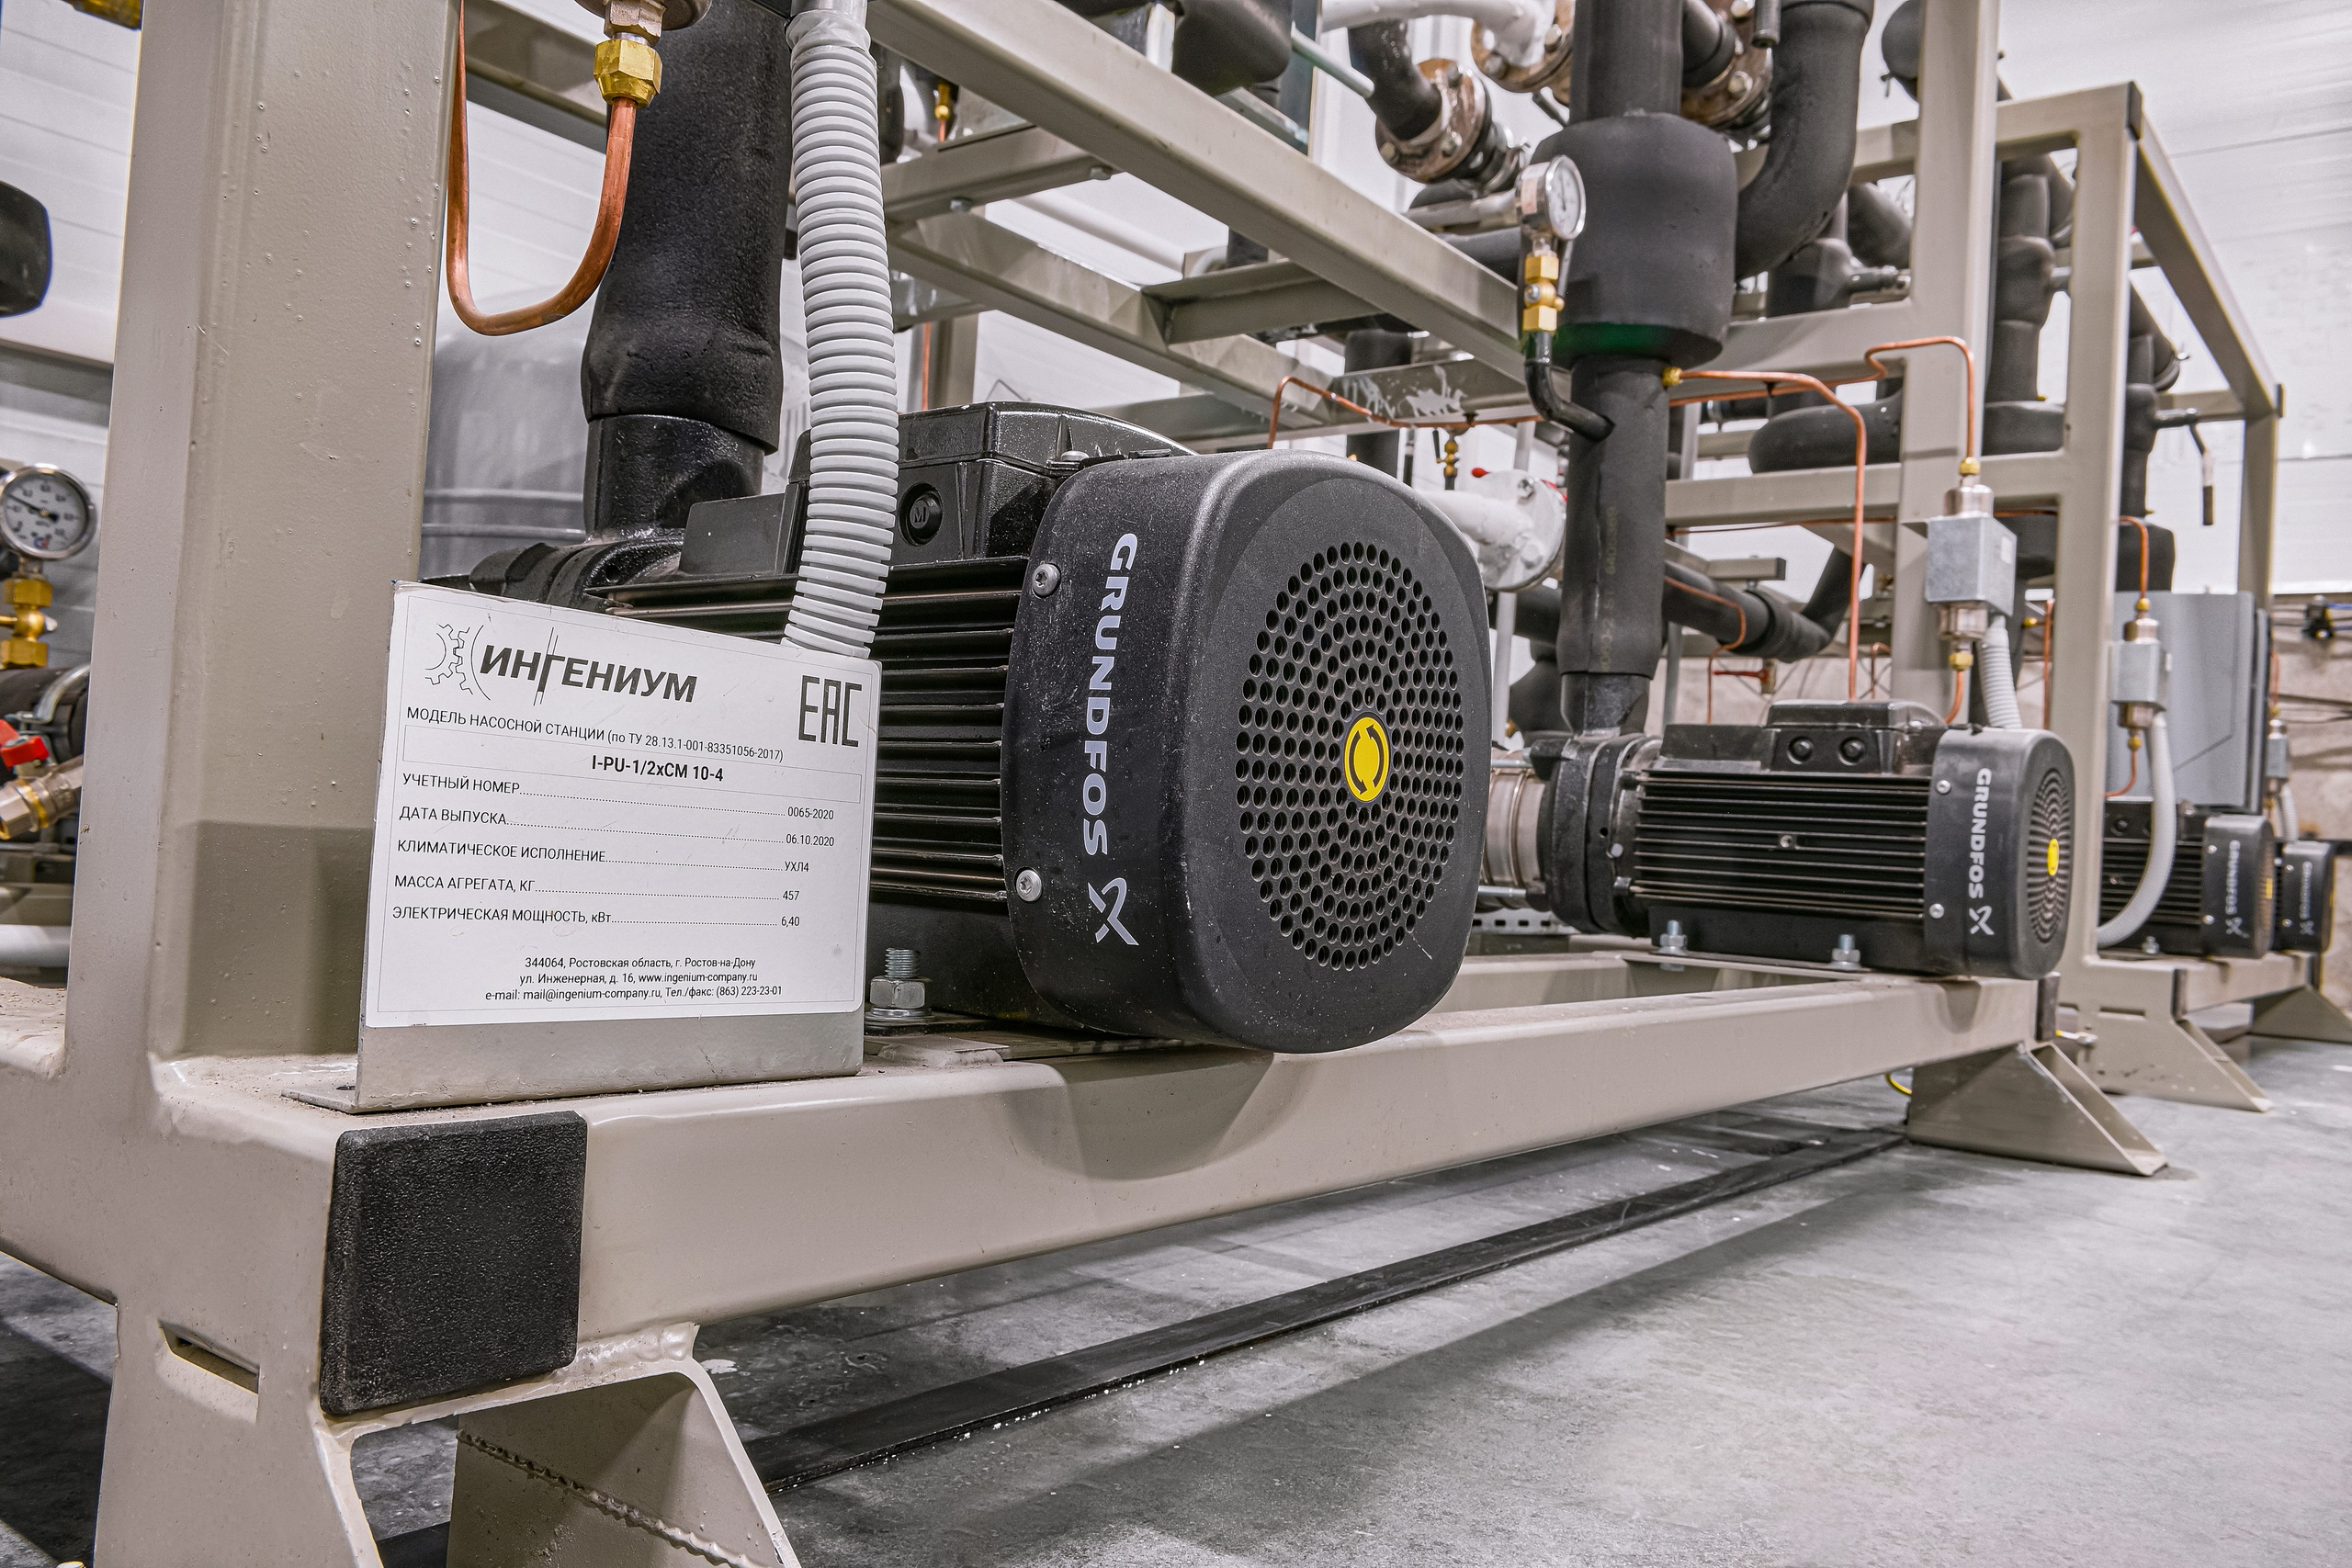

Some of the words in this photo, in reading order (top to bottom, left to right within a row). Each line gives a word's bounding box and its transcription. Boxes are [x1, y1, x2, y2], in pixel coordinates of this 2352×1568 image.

[480, 643, 697, 703] ИНГЕНИУМ
[1082, 533, 1138, 856] GRUNDFOS
[407, 706, 466, 724] МОДЕЛЬ
[470, 714, 541, 733] НАСОСНОЙ
[546, 723, 604, 740] СТАНЦИИ
[608, 729, 625, 744] (по
[628, 733, 642, 744] ТУ
[645, 734, 784, 762] 28.13.1-001-83351056-2017)
[694, 766, 723, 782] 10-4
[403, 773, 469, 790] УЧЕТНЫЙ
[788, 807, 833, 819] 0065-2020
[399, 807, 437, 821] ДАТА
[786, 834, 834, 846] 06.10.2020
[1968, 768, 1992, 899] GRUNDFOS
[398, 840, 517, 857] КЛИМАТИЧЕСКОЕ
[785, 862, 808, 872] УХЛ4
[395, 875, 444, 888] МАССА
[447, 877, 515, 893] АГРЕГАТА,
[783, 890, 799, 900] 457
[393, 907, 508, 920] ЭЛЕКТРИЧЕСКАЯ
[513, 909, 587, 924] МОЩНОСТЬ,
[782, 916, 799, 928] 6,40
[526, 957, 565, 969] 344064,
[570, 957, 628, 967] Ростовская
[632, 957, 673, 968] область,
[685, 957, 755, 969] Ростов-на-Дону
[486, 989, 520, 1000] e-mail:
[524, 987, 662, 1002] mail@ingenium-company.ru,
[665, 987, 714, 998] Тел./факс:
[717, 986, 739, 998] (863)
[741, 986, 781, 995] 223-23-01
[520, 976, 535, 987] ул.
[538, 974, 606, 986] Инженерная,
[609, 976, 618, 986] д.
[623, 973, 635, 984] 16,
[639, 973, 757, 985] www.ingenium-company.ru
